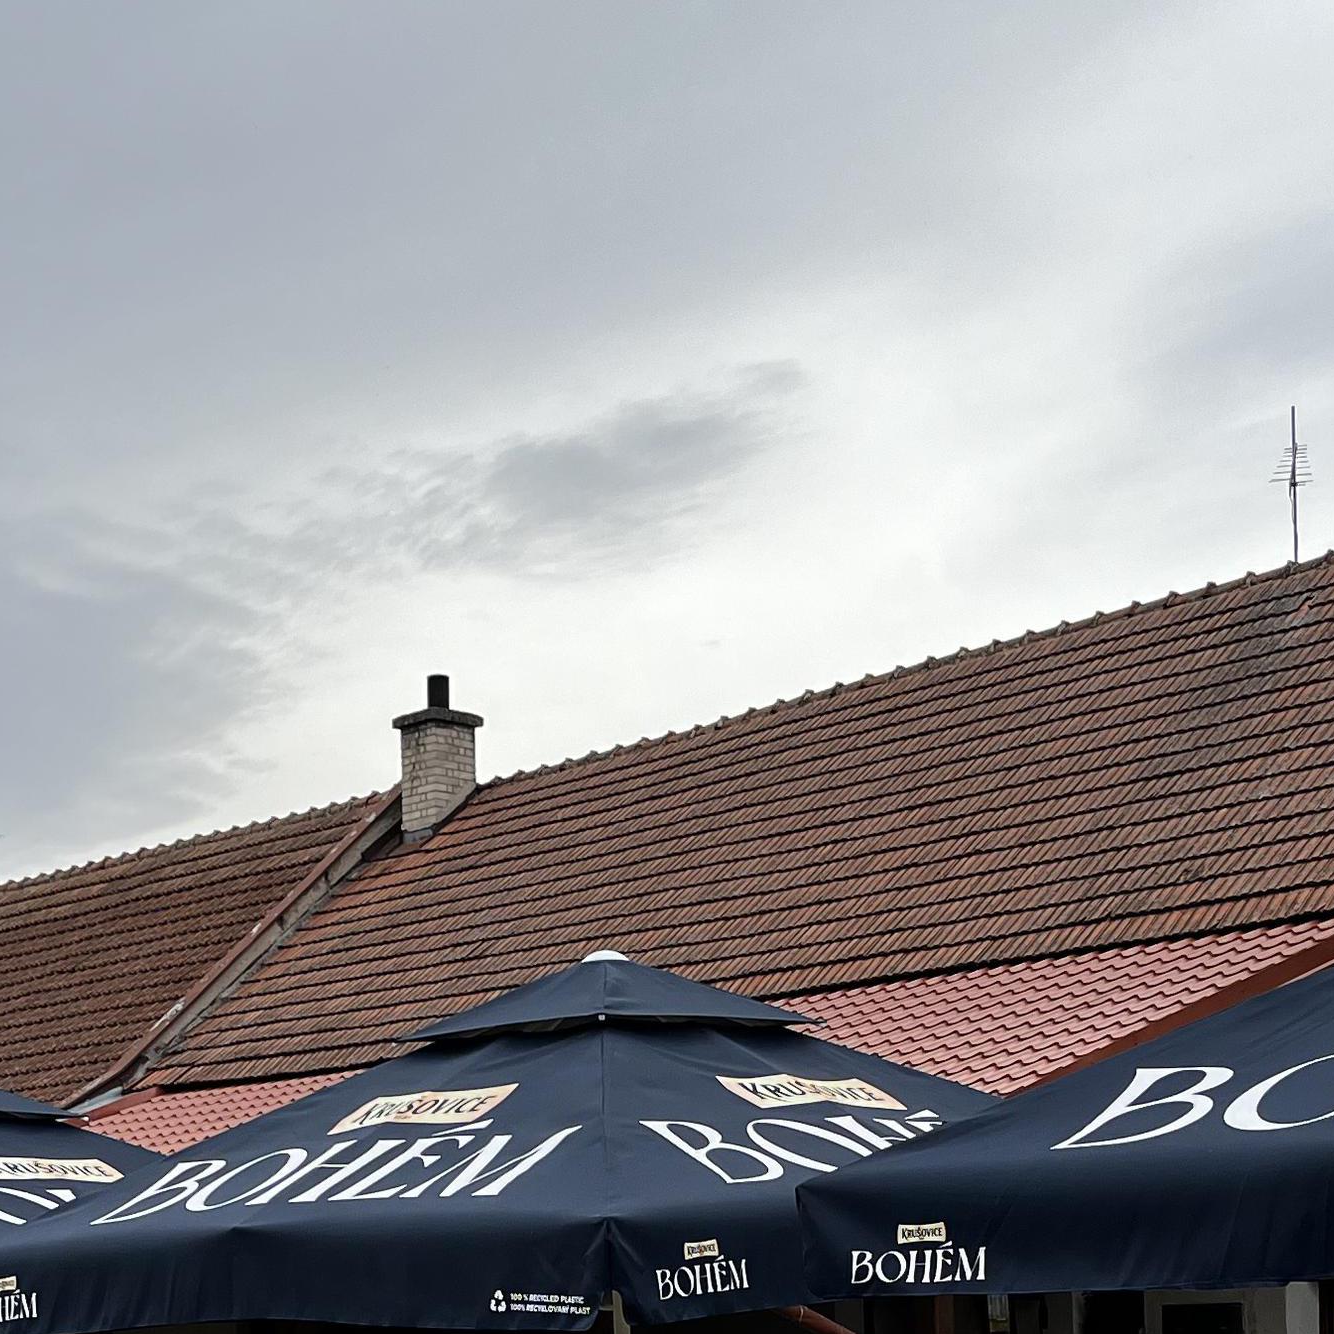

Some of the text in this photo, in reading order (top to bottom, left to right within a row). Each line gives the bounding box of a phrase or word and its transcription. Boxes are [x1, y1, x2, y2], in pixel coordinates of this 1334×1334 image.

[352, 1094, 497, 1125] KRUŠOVICE
[89, 1118, 583, 1225] BOHÉM
[901, 1226, 944, 1240] KRUŠOVICE
[655, 1254, 750, 1301] BOHÉM
[851, 1241, 987, 1285] BOHÉM
[570, 1306, 591, 1315] PLAST
